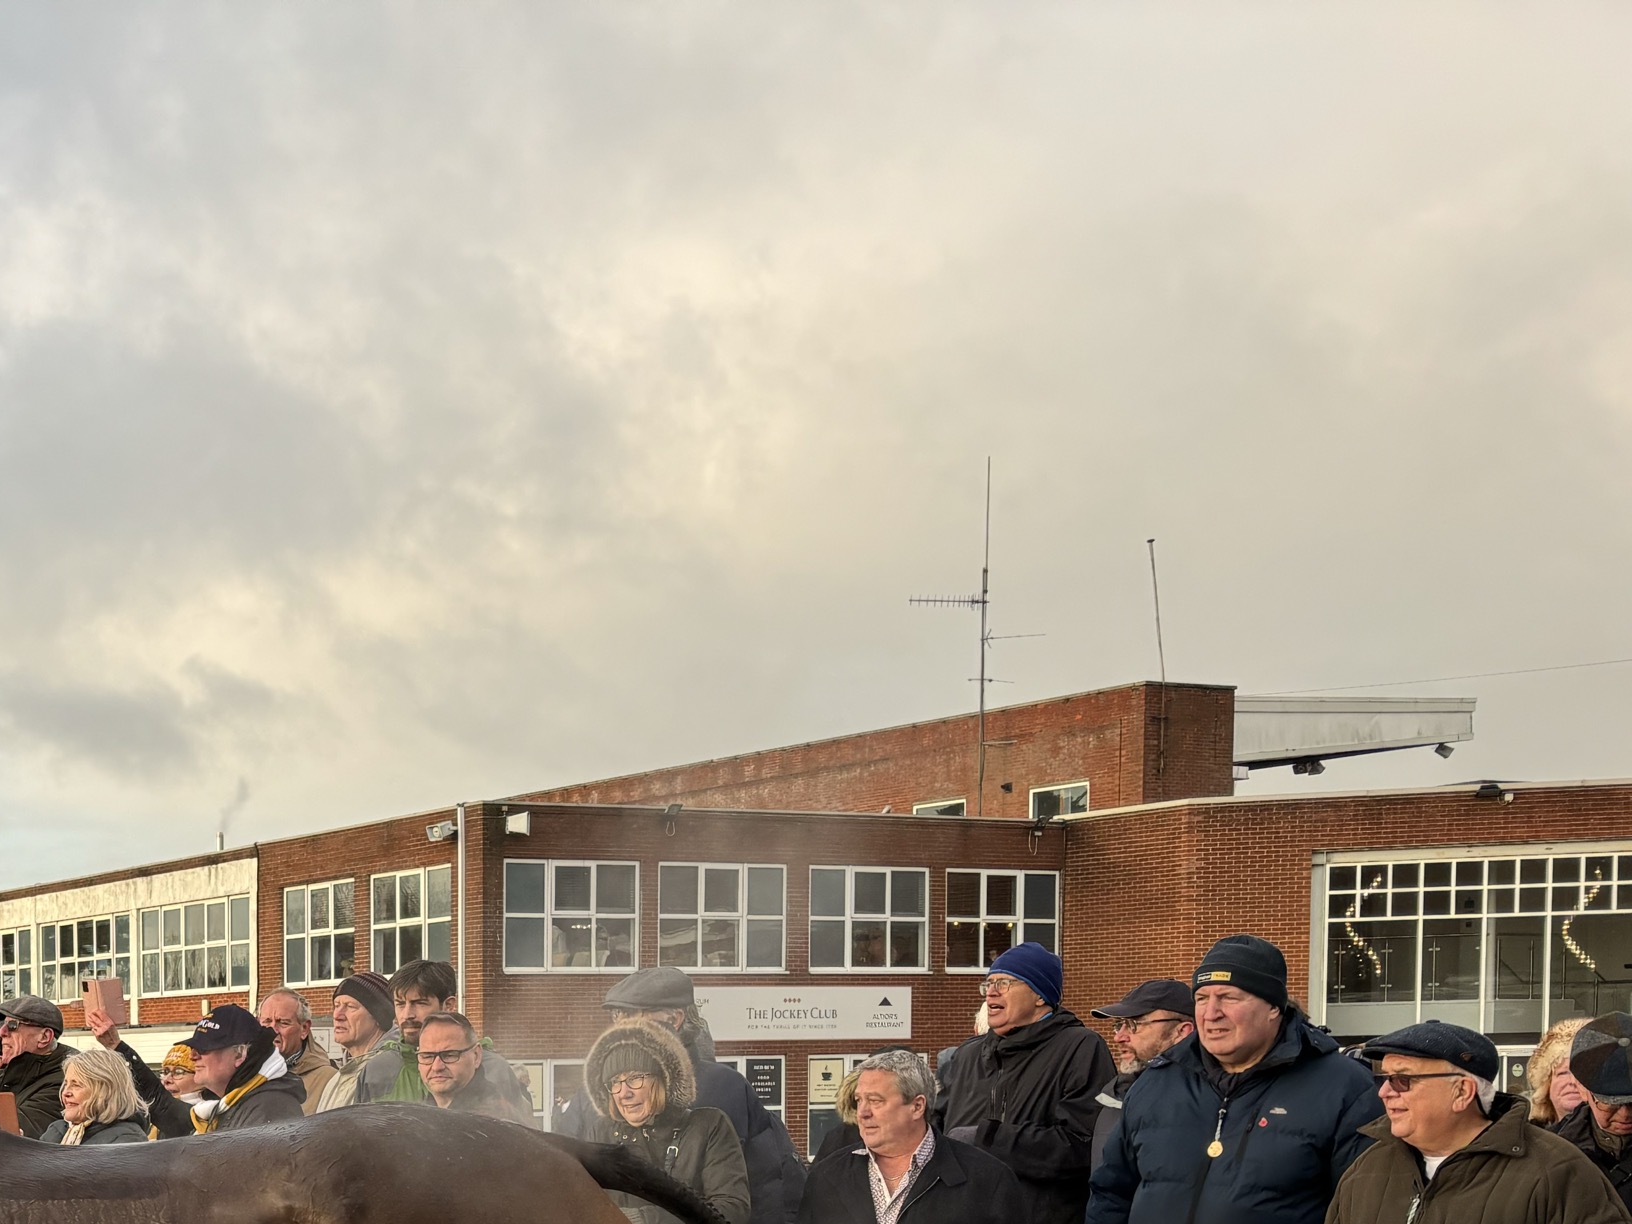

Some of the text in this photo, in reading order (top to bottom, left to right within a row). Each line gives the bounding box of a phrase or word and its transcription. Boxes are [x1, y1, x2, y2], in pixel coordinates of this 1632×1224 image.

[745, 1006, 838, 1022] THE JOCKEY CLUB
